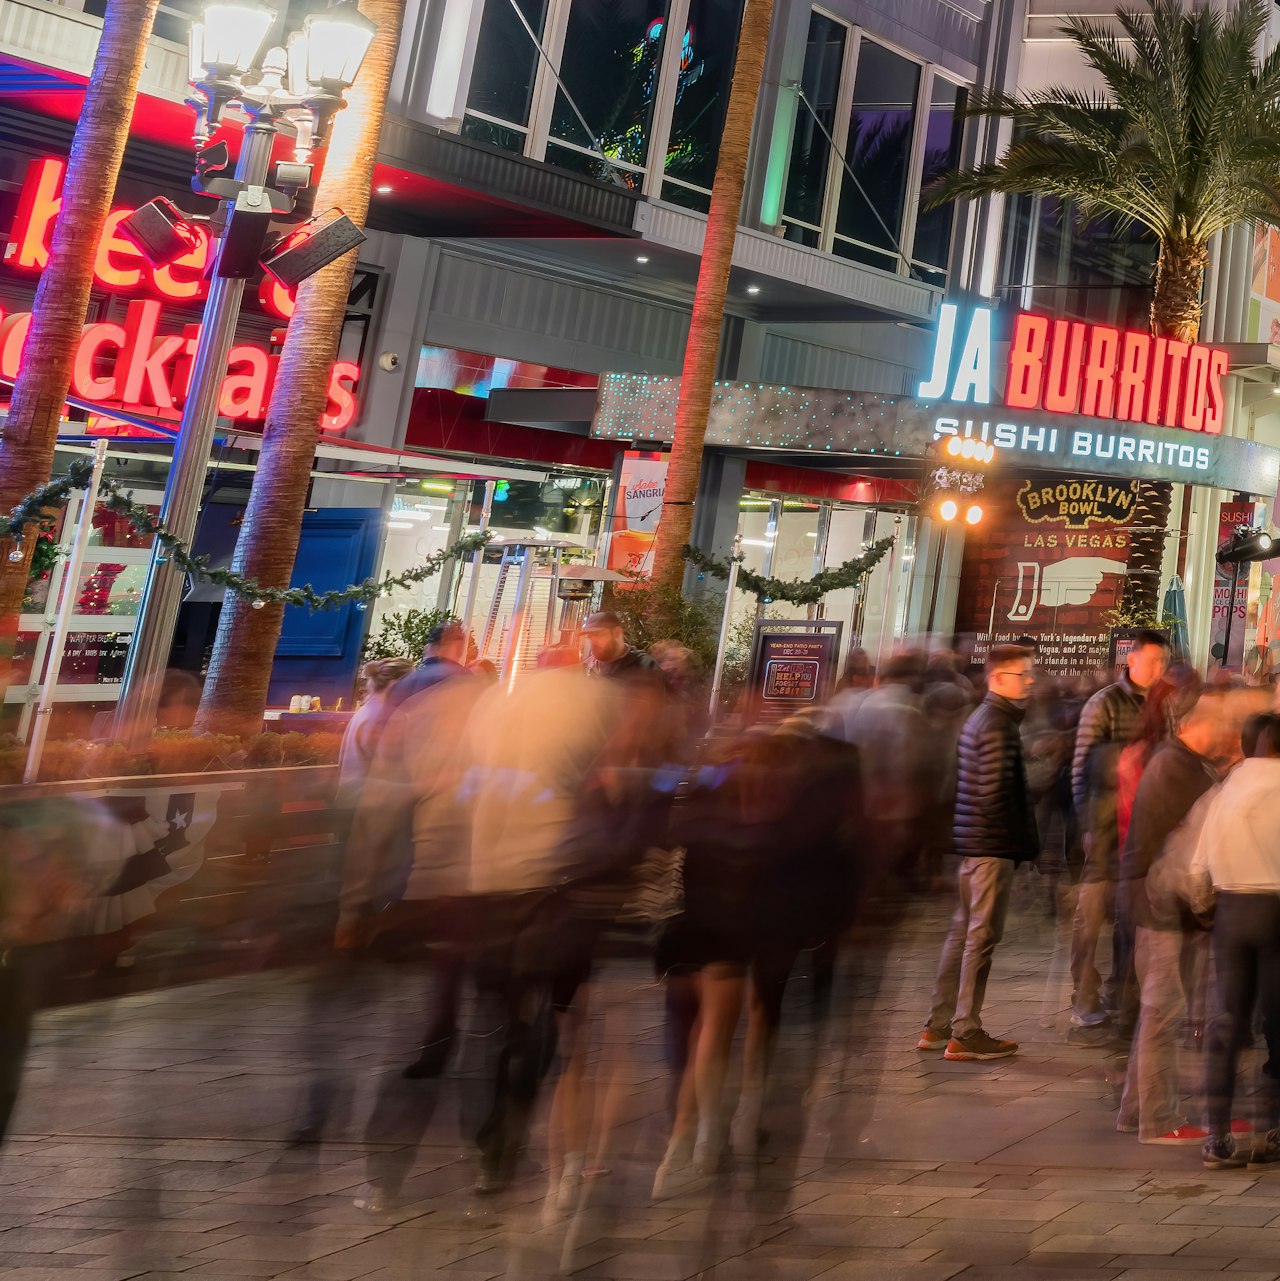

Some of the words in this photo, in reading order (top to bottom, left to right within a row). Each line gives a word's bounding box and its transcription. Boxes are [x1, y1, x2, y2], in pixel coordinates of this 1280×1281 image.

[917, 303, 991, 404] JA
[1004, 312, 1229, 434] BURRITOS
[932, 417, 1058, 452] SUSHI
[1073, 432, 1210, 470] BURRITOS
[632, 479, 659, 490] Sake
[1026, 482, 1133, 510] BROOKLYN
[1058, 501, 1102, 515] BOWL
[1221, 511, 1253, 523] SUSHI
[1024, 534, 1058, 548] LAS
[1065, 534, 1127, 548] VEGAS
[994, 632, 1010, 642] food
[1040, 633, 1061, 642] York's
[1062, 633, 1096, 643] legendary
[974, 644, 990, 653] best
[1039, 645, 1061, 655] Vegas,
[1062, 645, 1076, 654] and
[1077, 645, 1087, 654] 32
[1044, 656, 1068, 665] stands
[1070, 656, 1077, 665] in
[776, 672, 801, 680] HELP
[1060, 668, 1067, 677] of
[1069, 669, 1081, 677] the
